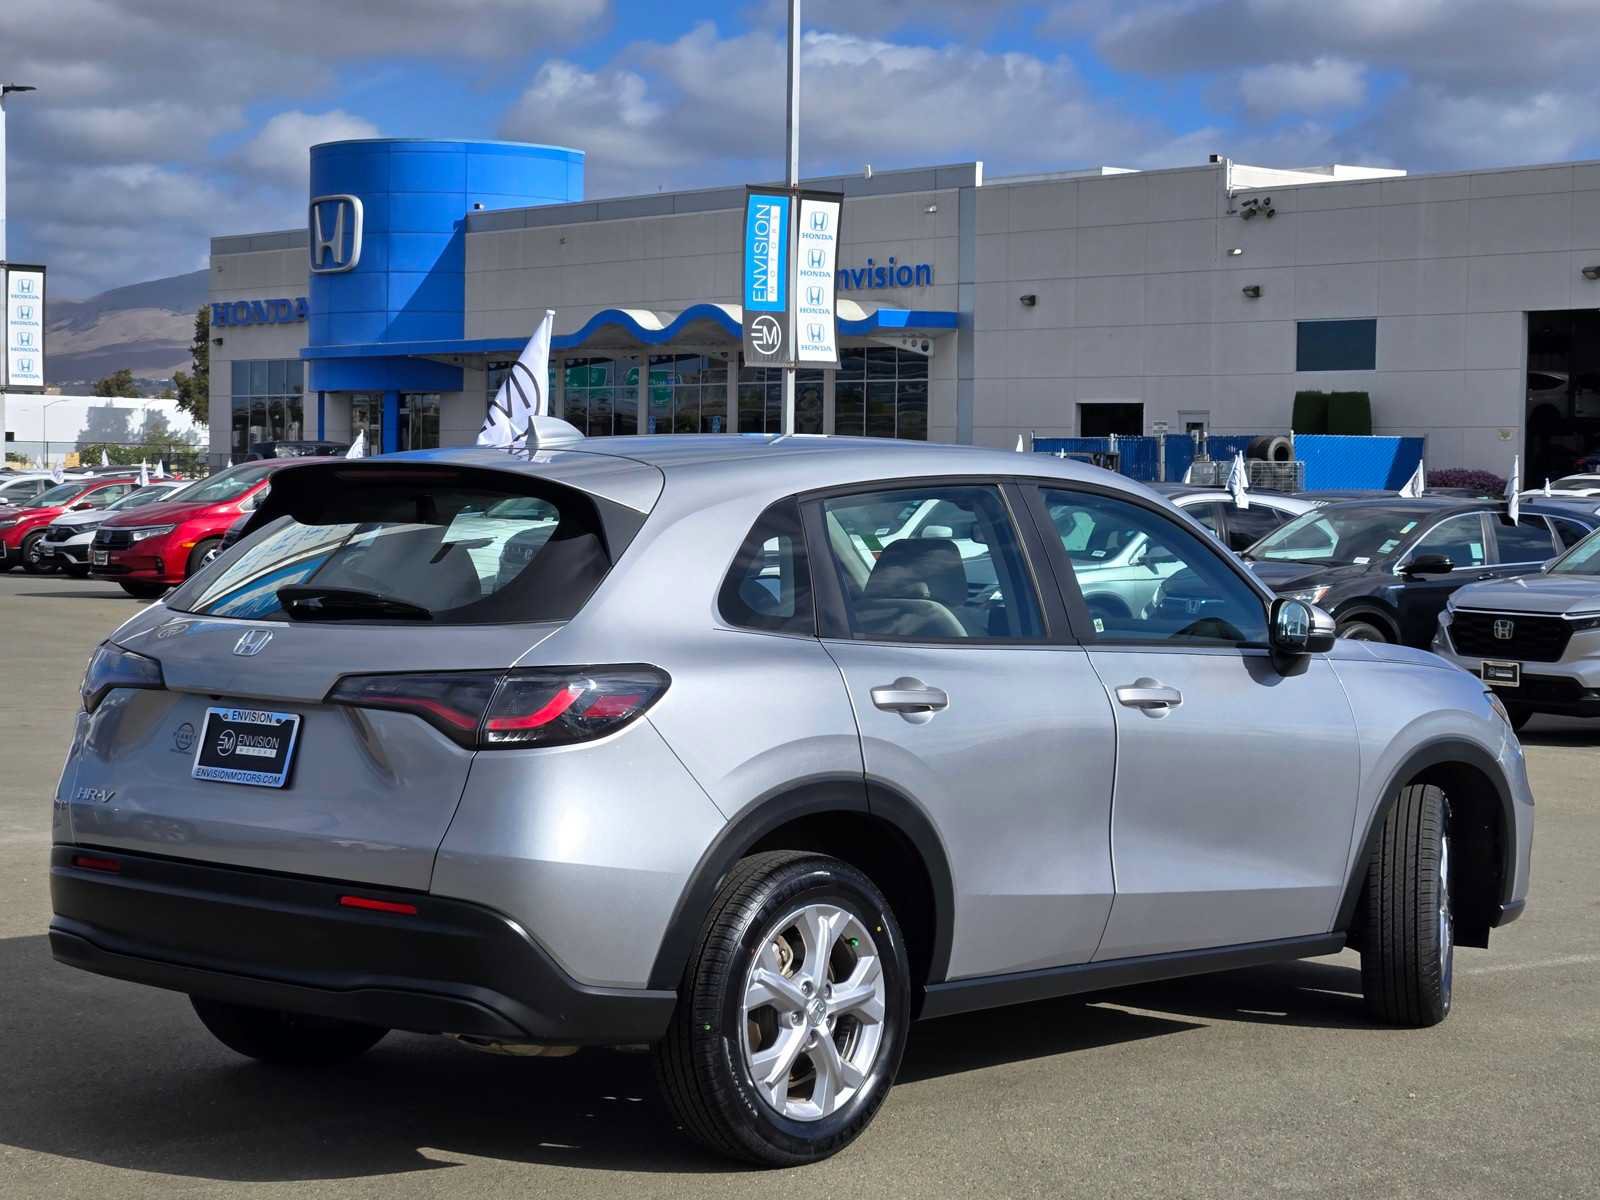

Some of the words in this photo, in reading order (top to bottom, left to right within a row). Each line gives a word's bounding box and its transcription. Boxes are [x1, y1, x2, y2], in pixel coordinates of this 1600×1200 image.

[801, 232, 833, 240] HONDA
[753, 204, 770, 301] ENVISION
[769, 214, 778, 294] MOTORS
[800, 270, 831, 278] HONDA
[834, 256, 932, 288] nvision
[210, 297, 310, 328] HONDA
[800, 344, 832, 352] HONDA
[231, 711, 273, 723] ENVISION
[237, 735, 280, 748] ENVISION
[195, 768, 281, 785] ENVISIONMOTORS.COM
[76, 787, 116, 803] HR-V
